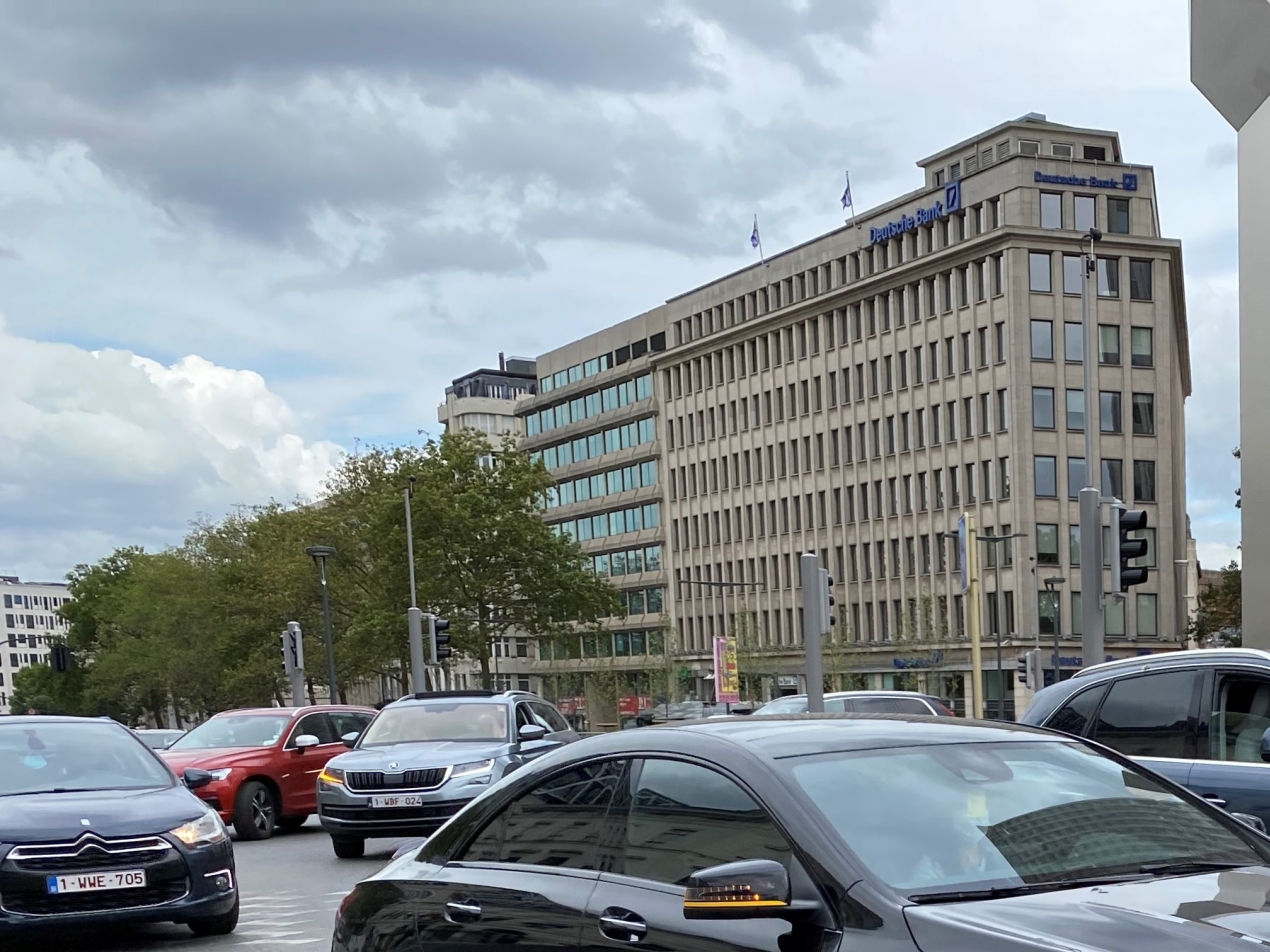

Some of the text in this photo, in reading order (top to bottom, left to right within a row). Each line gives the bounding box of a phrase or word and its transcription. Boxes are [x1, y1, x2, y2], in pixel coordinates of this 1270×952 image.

[1034, 171, 1118, 188] Deutsche Bank
[869, 201, 943, 244] Deutsche Bank
[60, 872, 143, 890] 1-WWE-705
